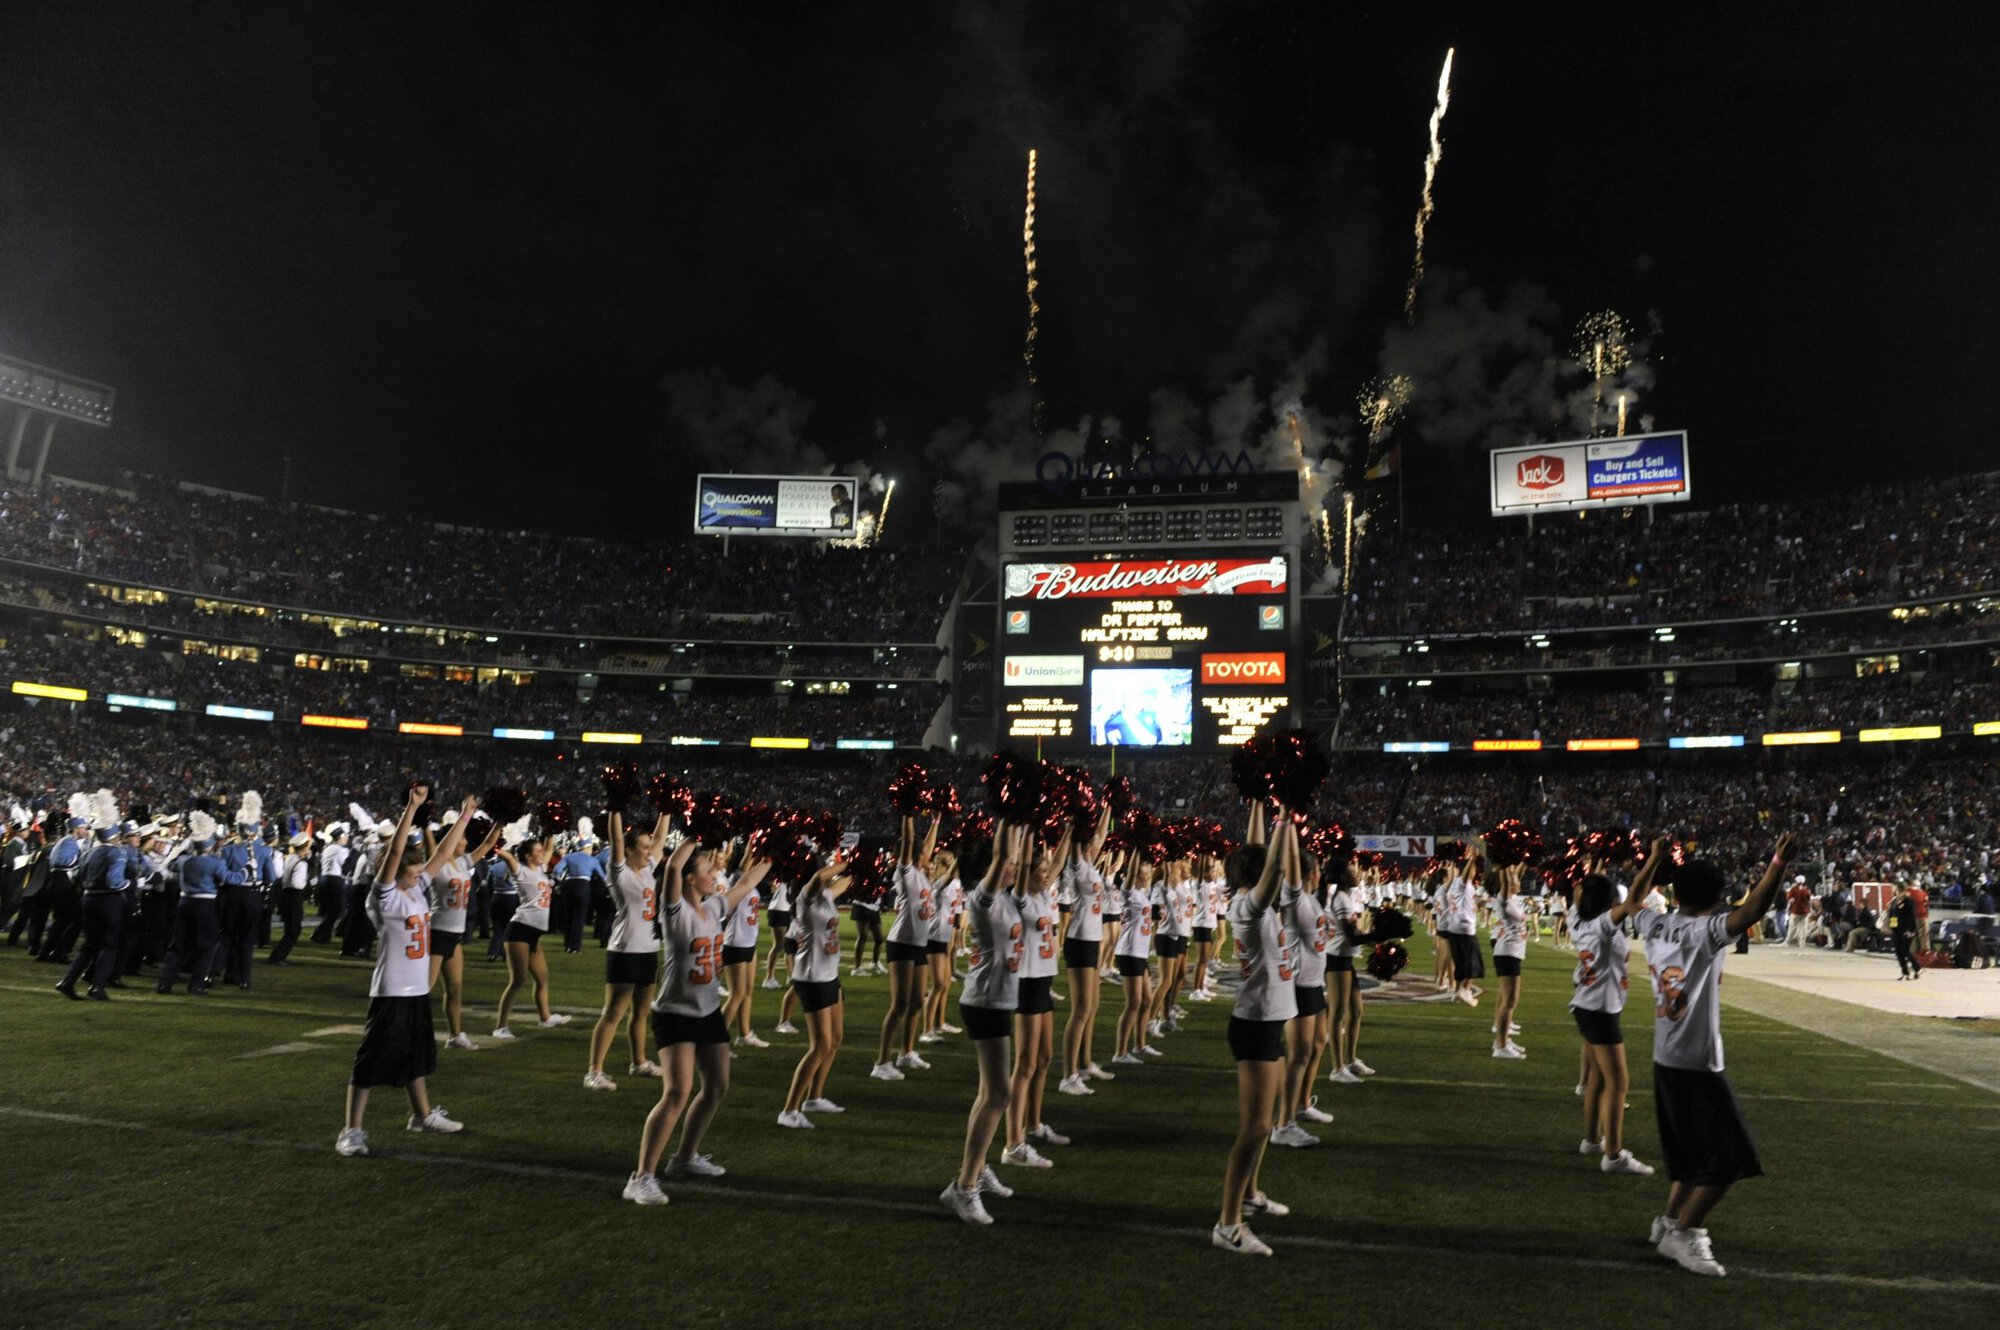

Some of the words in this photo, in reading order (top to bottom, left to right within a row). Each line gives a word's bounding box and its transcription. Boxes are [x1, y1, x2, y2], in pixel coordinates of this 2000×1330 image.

[1519, 458, 1563, 486] Jack
[1605, 460, 1624, 472] Buy
[1625, 457, 1644, 469] and
[1645, 456, 1664, 467] Sell
[1593, 470, 1638, 484] Chargers
[1639, 466, 1677, 480] Tickets!
[1081, 482, 1238, 497] STADIUM
[703, 491, 774, 508] QUALCOMM
[1031, 560, 1218, 599] Budweiser
[1157, 601, 1173, 612] TO
[1101, 614, 1123, 627] DR
[1127, 613, 1182, 626] PEPPER
[1081, 628, 1159, 641] HALFTIME
[1167, 627, 1208, 640] SHOW
[962, 660, 992, 673] Sprint
[1205, 661, 1282, 677] TOYOTA
[1475, 740, 1507, 750] WELLS
[1508, 740, 1541, 750] FARGO
[1407, 837, 1427, 855] N
